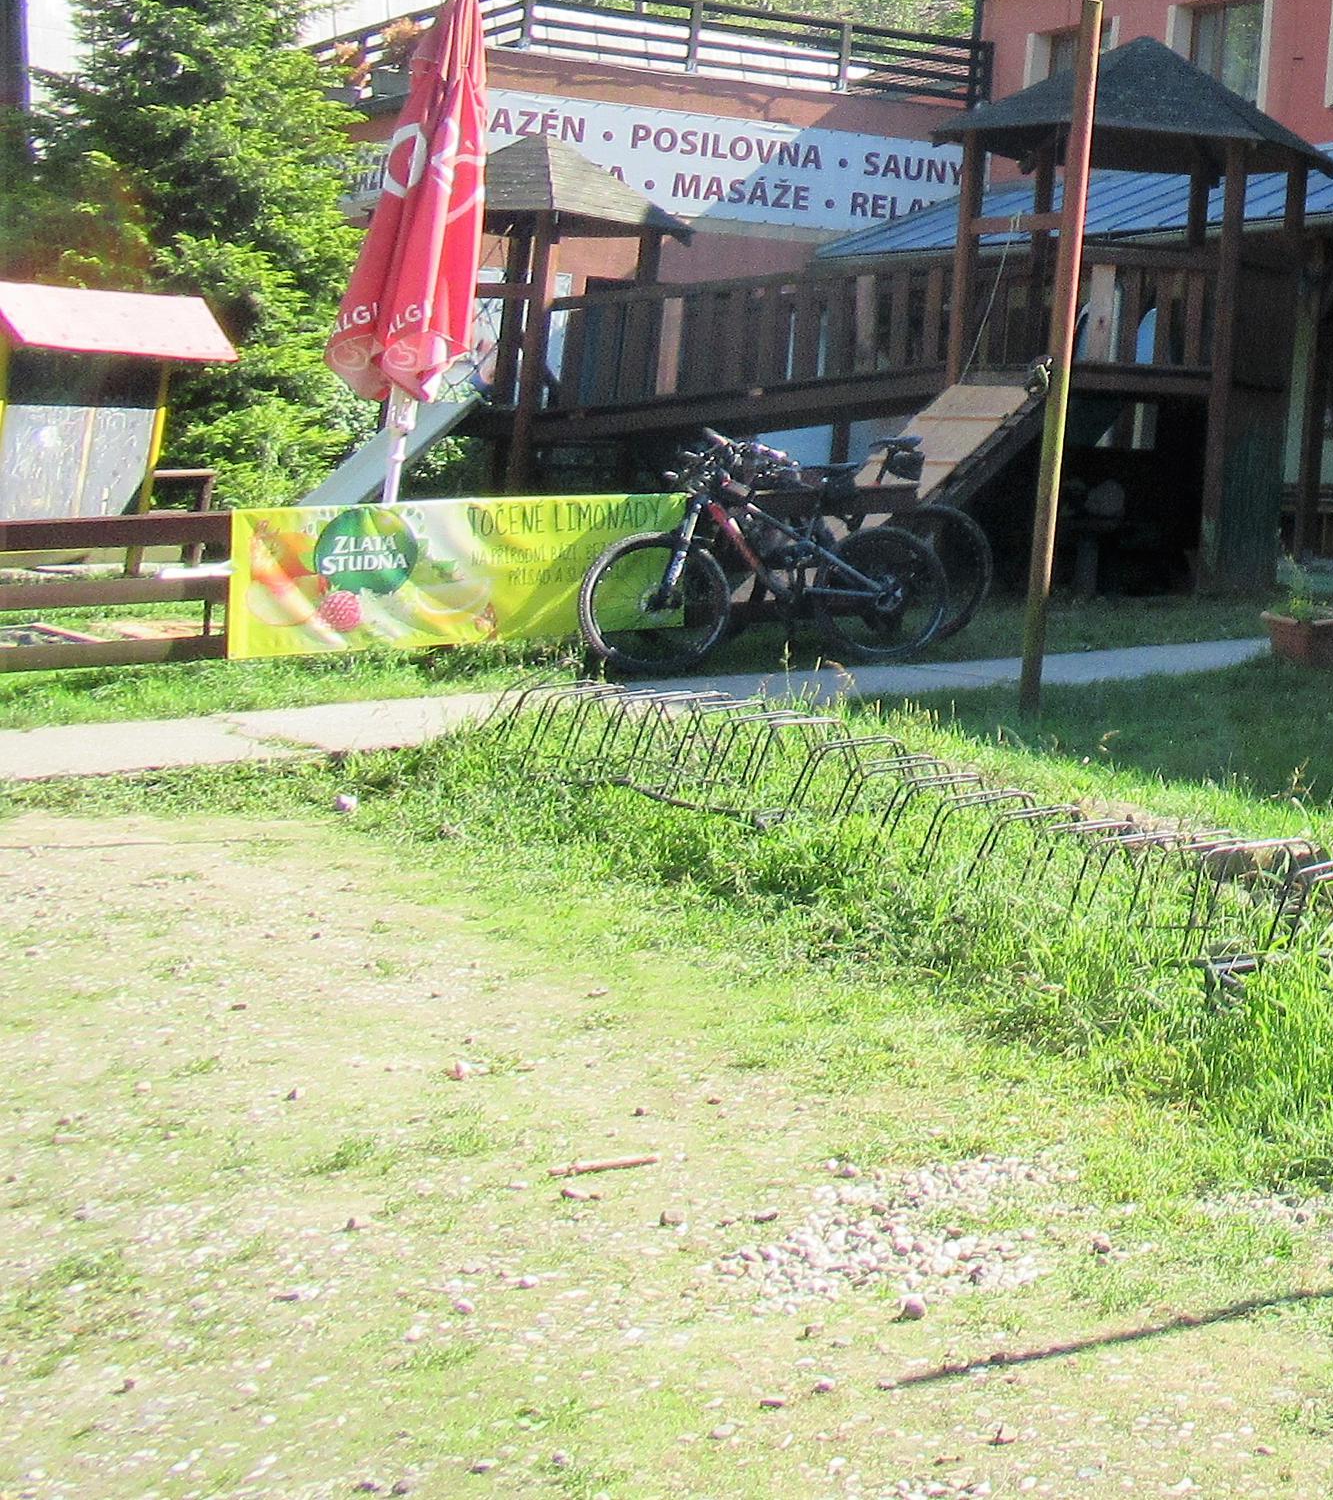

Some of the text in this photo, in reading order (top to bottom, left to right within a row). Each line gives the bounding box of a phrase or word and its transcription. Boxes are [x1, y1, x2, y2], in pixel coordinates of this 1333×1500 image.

[489, 108, 585, 142] AZÉN
[631, 124, 822, 170] POSILOVNA
[672, 172, 938, 220] MASÁŽE RELA
[467, 501, 545, 537] TOČENÉ
[332, 533, 398, 554] ZLATÁ
[321, 550, 409, 575] STUDŇA
